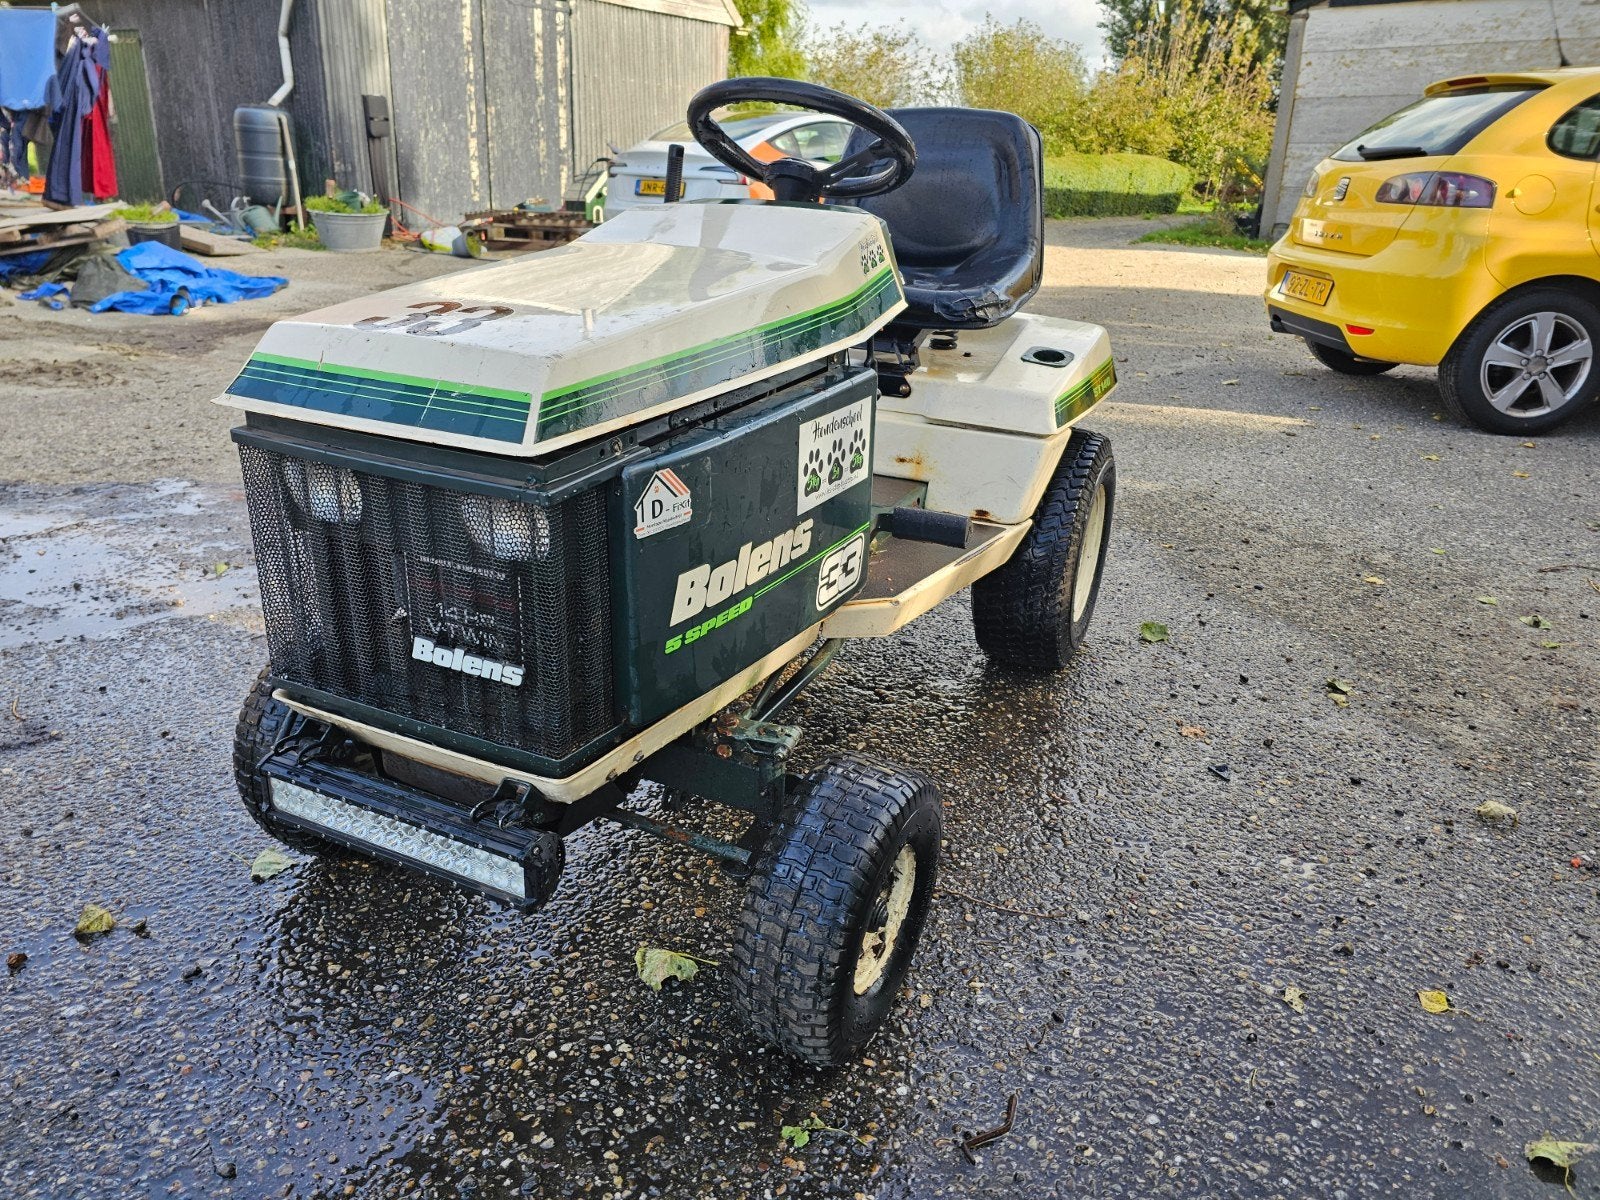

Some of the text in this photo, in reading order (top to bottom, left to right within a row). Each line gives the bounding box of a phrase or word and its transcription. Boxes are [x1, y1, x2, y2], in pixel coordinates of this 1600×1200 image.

[1288, 275, 1327, 301] 92-ZL-TR
[353, 301, 515, 337] 33
[670, 518, 814, 627] Bolens
[818, 537, 863, 605] 33
[665, 596, 753, 655] 5 SPEED
[412, 636, 524, 686] Bolens
